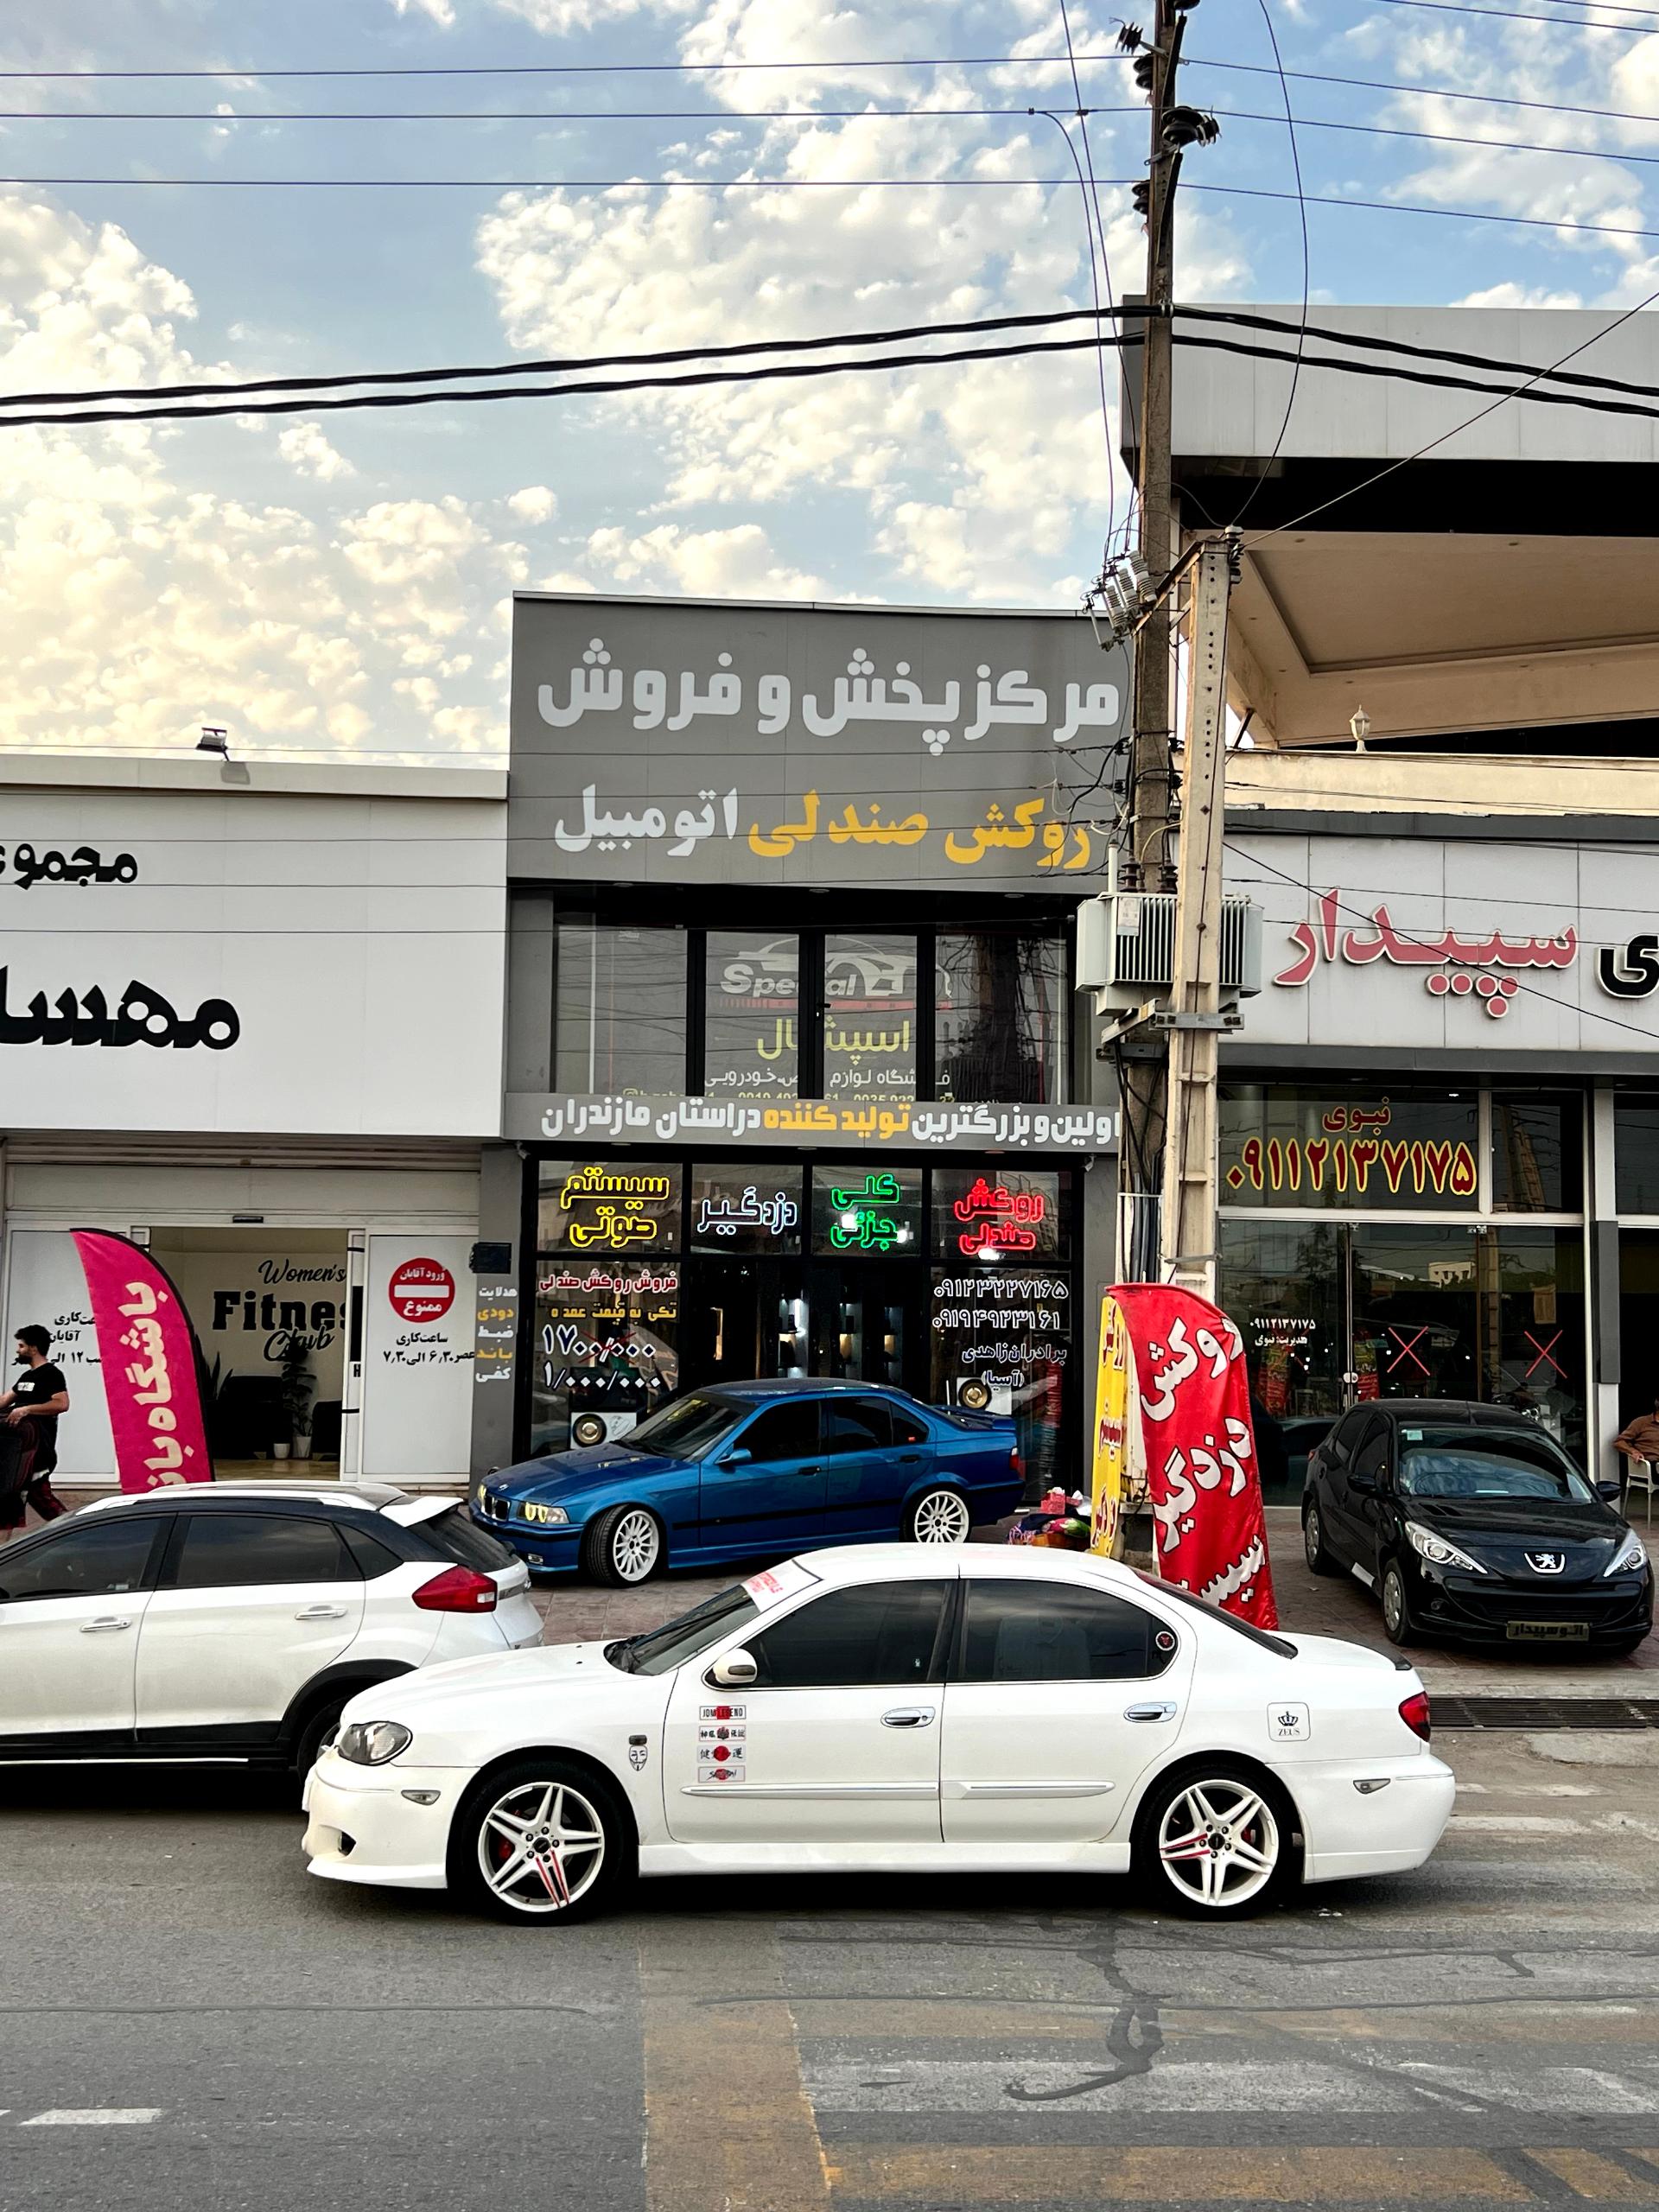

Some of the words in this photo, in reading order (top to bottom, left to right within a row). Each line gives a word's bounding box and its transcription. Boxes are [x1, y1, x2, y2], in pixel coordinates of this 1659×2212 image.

[537, 638, 741, 731] فروش
[802, 647, 960, 756] پخش
[757, 674, 791, 734] و
[964, 664, 1120, 742] مرکز
[554, 783, 738, 857] اتومبیل
[749, 788, 929, 858] صندلی
[944, 798, 1091, 869] روکش
[1274, 886, 1578, 1019] سپیدار
[720, 963, 857, 997] Speal
[830, 1069, 872, 1087] لوازم
[541, 1096, 651, 1138] مازندران
[656, 1098, 734, 1139] استان
[733, 1109, 761, 1136] در
[764, 1103, 836, 1130] کننده
[842, 1104, 911, 1139] تولید
[912, 1103, 1030, 1147] بزرگترین
[1034, 1116, 1050, 1143] و
[1052, 1110, 1121, 1146] اولین
[1322, 1096, 1390, 1136] نبوی
[561, 1166, 670, 1210] سیستم
[831, 1174, 900, 1210] کلی
[955, 1178, 1044, 1224] روکش
[569, 1206, 657, 1248] صوتی
[697, 1186, 798, 1235] دزدگیر
[959, 1221, 1037, 1255] صندلی
[257, 1258, 346, 1285] Women's
[399, 1267, 425, 1281] آقایان
[426, 1270, 446, 1281] ورود
[539, 1270, 580, 1291] صندلی
[582, 1268, 632, 1294] روکش
[634, 1268, 677, 1294] فروش
[213, 1290, 346, 1331] Fitne
[403, 1300, 442, 1316] ممنوع
[477, 1307, 514, 1321] دودی
[648, 1302, 677, 1321] تکی
[477, 1325, 514, 1342] ضبط
[118, 1281, 177, 1431] باشگاه
[476, 1347, 513, 1363] باند
[962, 1343, 1008, 1363] زاهدی
[1008, 1344, 1067, 1366] برادران
[1141, 1316, 1244, 1421] روکش
[475, 1366, 512, 1382] کفی
[1154, 1418, 1253, 1553] دزدگیر
[1277, 1727, 1300, 1736] ZEUS
